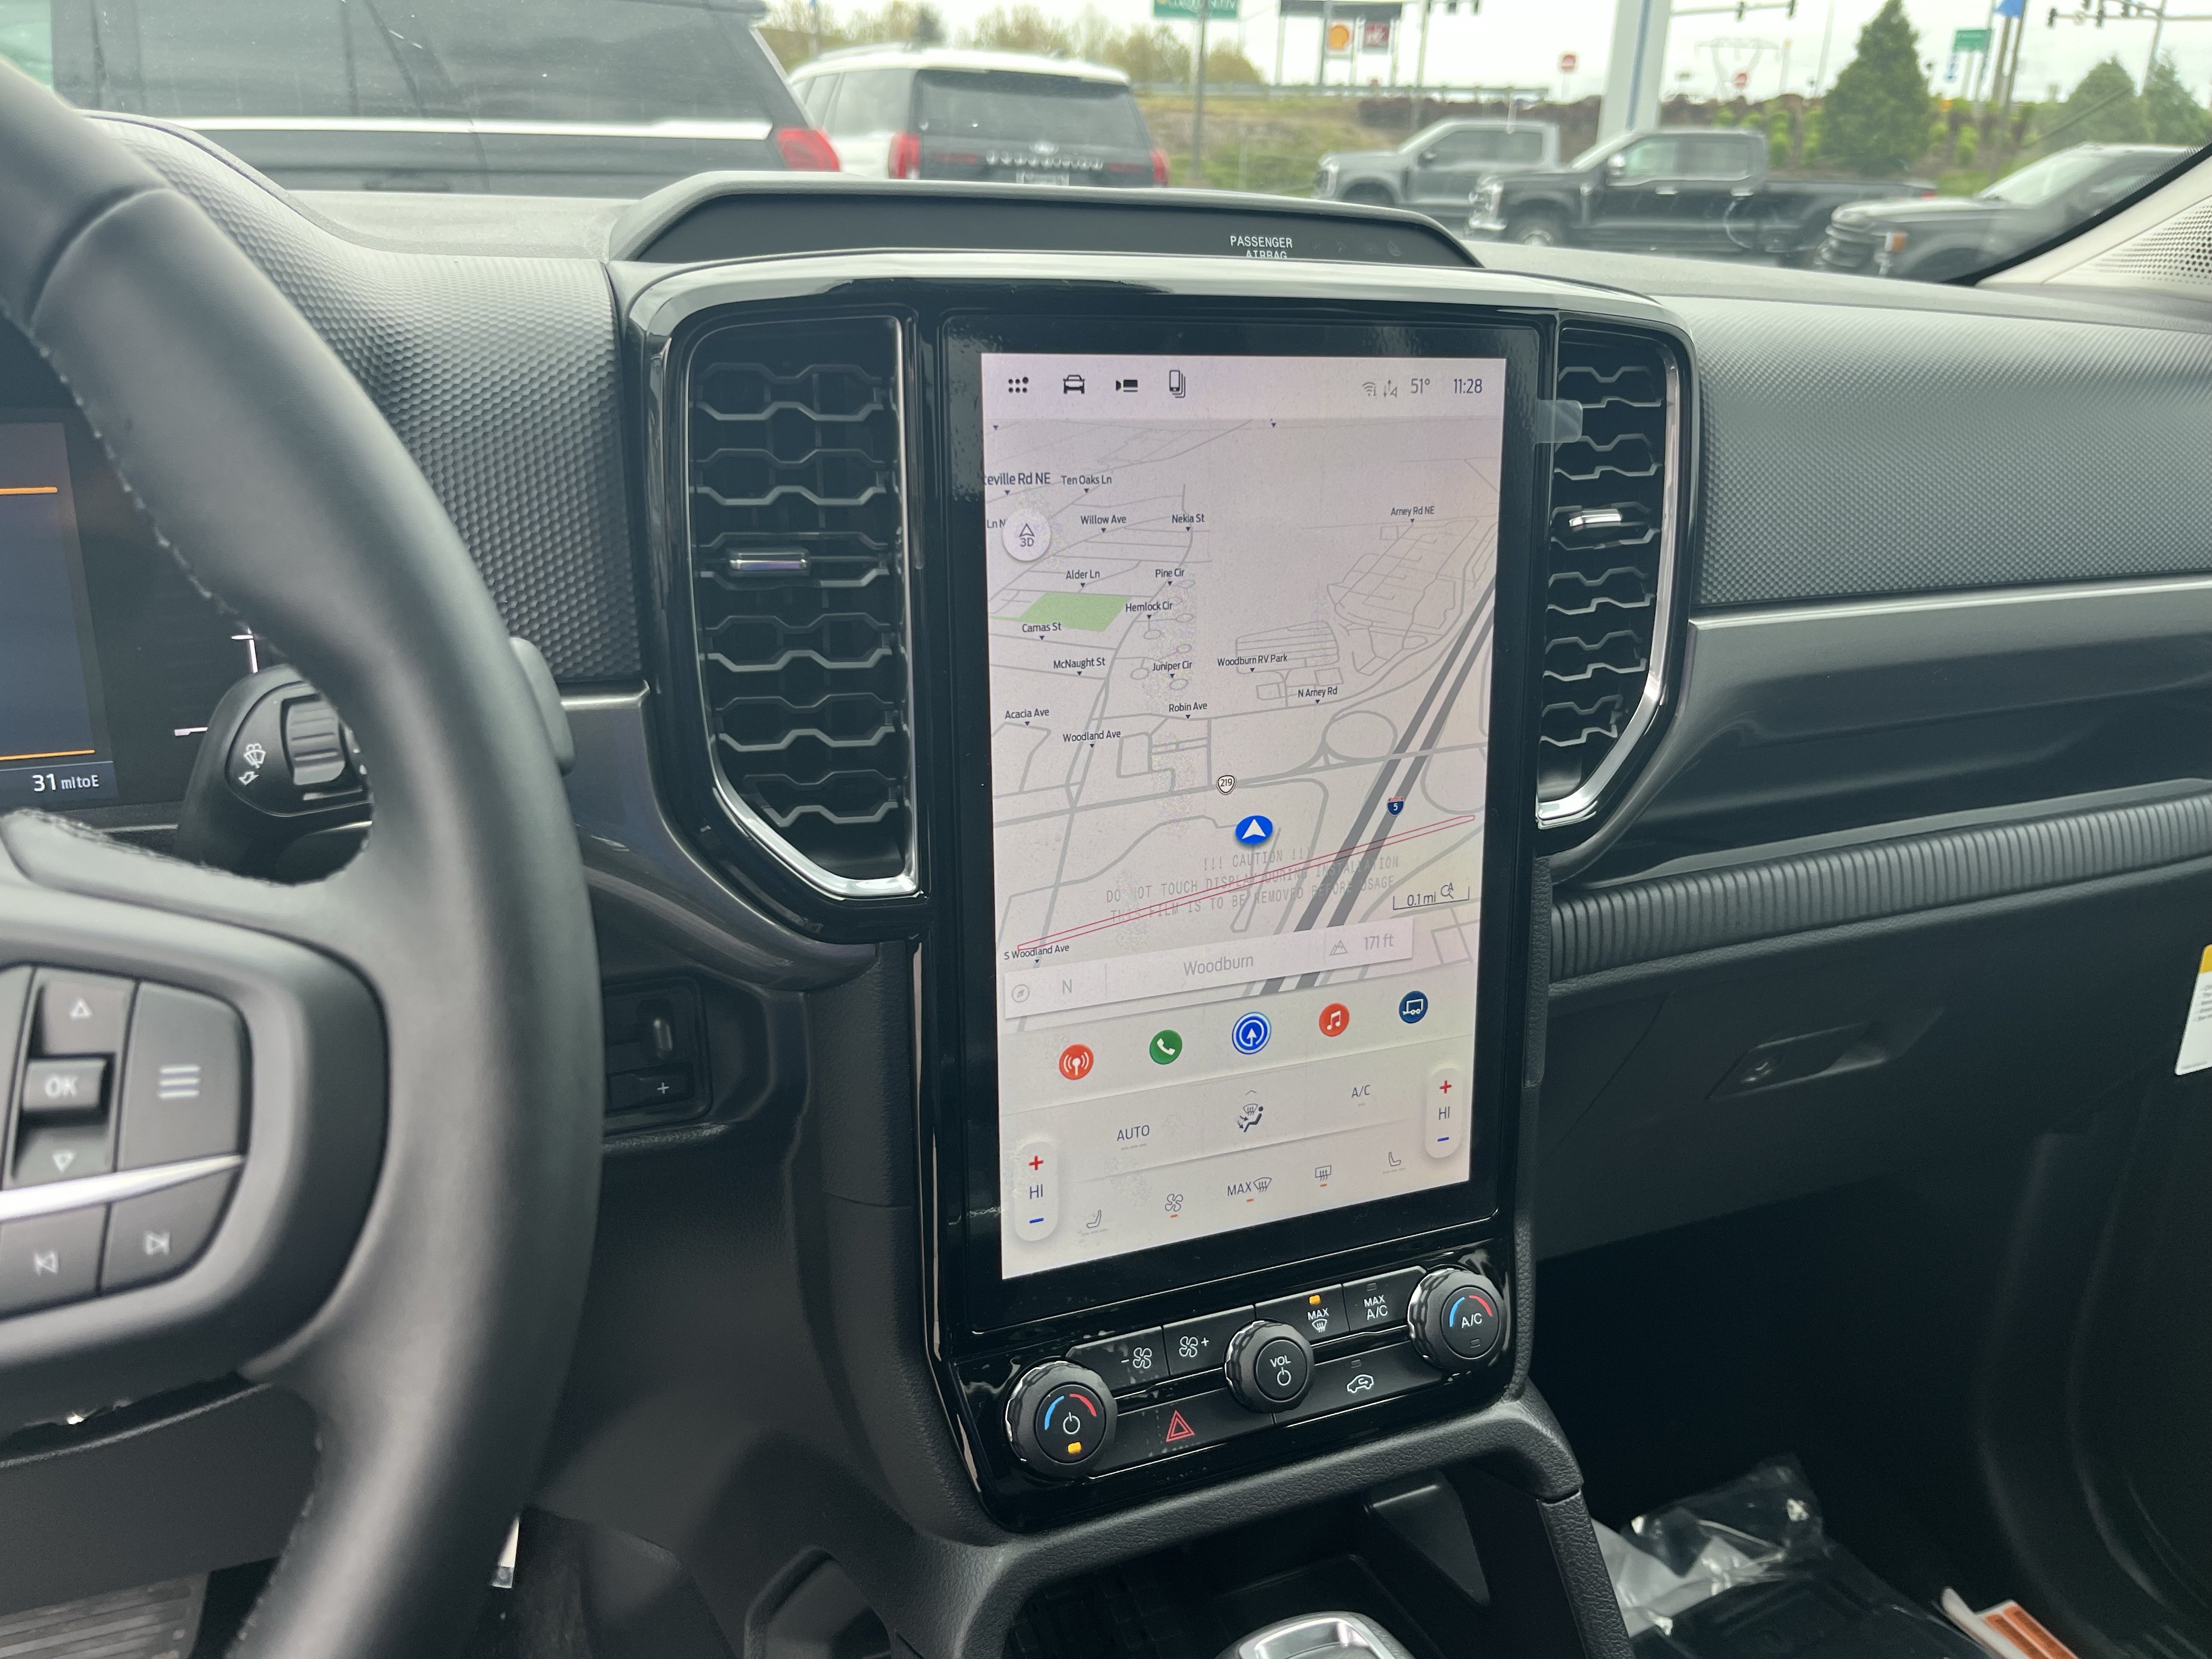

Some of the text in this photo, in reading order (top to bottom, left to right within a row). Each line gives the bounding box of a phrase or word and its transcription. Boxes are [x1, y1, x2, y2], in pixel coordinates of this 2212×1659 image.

[1230, 236, 1293, 248] PASSENGER
[1410, 378, 1430, 394] 51°
[1454, 378, 1482, 394] 11:28
[1018, 472, 1032, 485] Rd
[1035, 472, 1051, 484] NE
[1061, 475, 1111, 485] Ten Oaks Ln
[1391, 506, 1435, 517] Arney Rd NE
[987, 520, 997, 528] Ln
[1081, 515, 1126, 524] Willow Ave
[1195, 514, 1204, 523] St
[1020, 538, 1034, 547] 3D
[1066, 569, 1100, 580] Alder Ln
[1155, 568, 1184, 578] Pine Cir
[1125, 601, 1172, 612] Hemlock Cir
[1022, 622, 1062, 633] Camas St
[1053, 657, 1105, 669] McNaught St
[1152, 660, 1192, 673] Juniper Cir
[1217, 653, 1288, 667] Woodburn RV Park
[1298, 686, 1338, 698] N Arney Rd
[1005, 708, 1049, 719] Acacia Ave
[1169, 702, 1207, 712] Robin Ave
[1063, 730, 1121, 742] Woodland Ave
[32, 774, 56, 792] 31
[1220, 778, 1232, 787] 219
[1393, 803, 1398, 811] 5
[1232, 850, 1283, 867] CAUTION
[1107, 889, 1121, 902] DO
[1161, 879, 1198, 896] TOUCH
[1206, 872, 1256, 890] DISPLAY
[1317, 856, 1398, 877] INSTALLATION
[1210, 896, 1223, 910] TO
[1232, 894, 1245, 907] BE
[1255, 887, 1304, 904] REMOVED
[1312, 880, 1352, 897] BEFORE
[1407, 892, 1436, 906] 0.1 mi
[1364, 934, 1394, 950] 171 ft
[1004, 944, 1070, 960] S Woodland Ave
[1184, 955, 1254, 976] Woodburn
[1062, 979, 1072, 994] N
[44, 1075, 77, 1098] OK
[1351, 1085, 1370, 1098] A/C
[1438, 1106, 1450, 1120] HI
[1116, 1125, 1149, 1142] AUTO
[1029, 1184, 1043, 1200] HI
[1228, 1181, 1251, 1197] MAX
[1364, 1295, 1386, 1308] MAX
[1307, 1308, 1329, 1321] MAX
[1367, 1305, 1388, 1321] A/C
[1461, 1313, 1482, 1329] A/C
[1270, 1356, 1291, 1367] VOL
